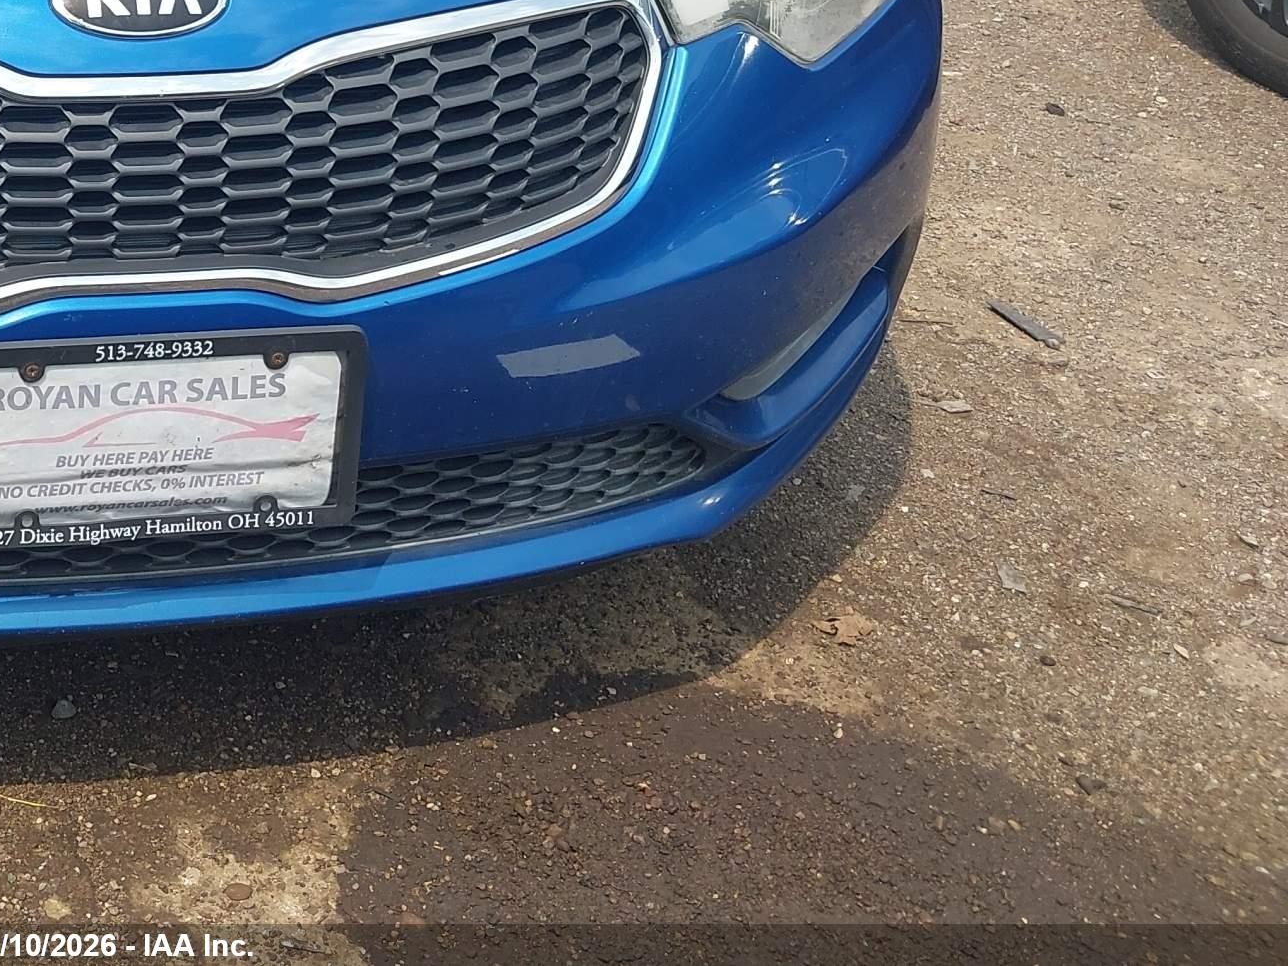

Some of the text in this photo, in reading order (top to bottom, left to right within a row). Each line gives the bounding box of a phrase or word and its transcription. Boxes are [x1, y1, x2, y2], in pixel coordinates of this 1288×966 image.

[95, 340, 214, 362] 513-748-9332
[110, 379, 178, 407] CAR
[186, 372, 286, 403] SALES
[56, 447, 214, 468] BUY HERE PAY HERE
[80, 464, 188, 480] WE BUY CARS
[27, 483, 88, 498] CREDIT
[89, 478, 157, 494] CHECKS,
[160, 477, 186, 490] 0%
[189, 471, 265, 489] INTEREST
[34, 496, 228, 514] www.royancarsales.com
[20, 528, 64, 545] Dixie
[69, 523, 141, 546] Highway
[145, 516, 222, 535] Hamilton
[228, 513, 259, 529] OH
[265, 510, 314, 527] 45011
